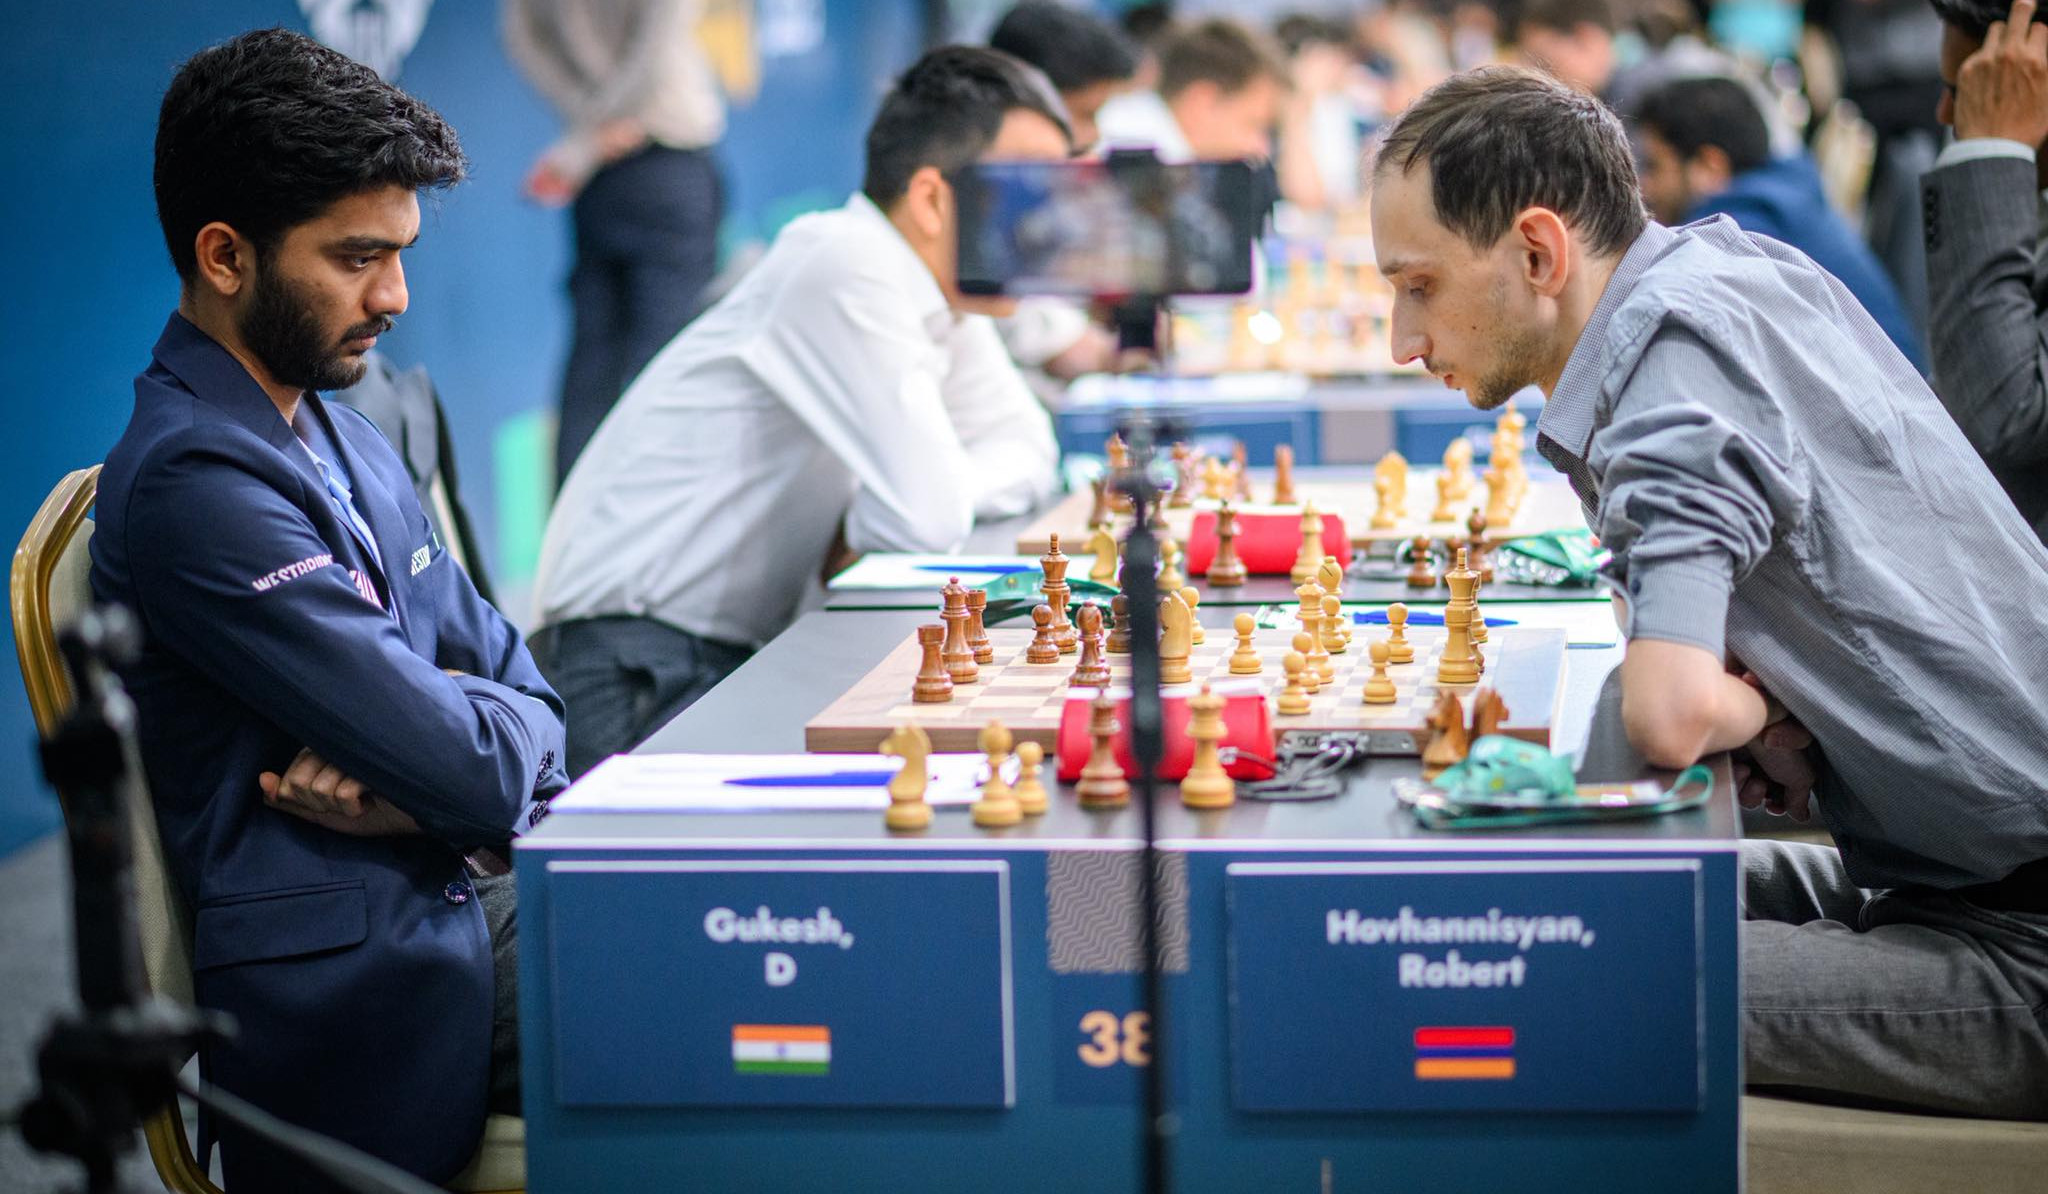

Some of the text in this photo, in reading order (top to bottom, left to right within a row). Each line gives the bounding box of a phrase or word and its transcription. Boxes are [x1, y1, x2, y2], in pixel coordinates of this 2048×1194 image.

[704, 905, 854, 949] Gukesh,
[1326, 905, 1596, 950] Hovhannisyan,
[765, 952, 797, 987] D
[1399, 949, 1527, 987] Robert
